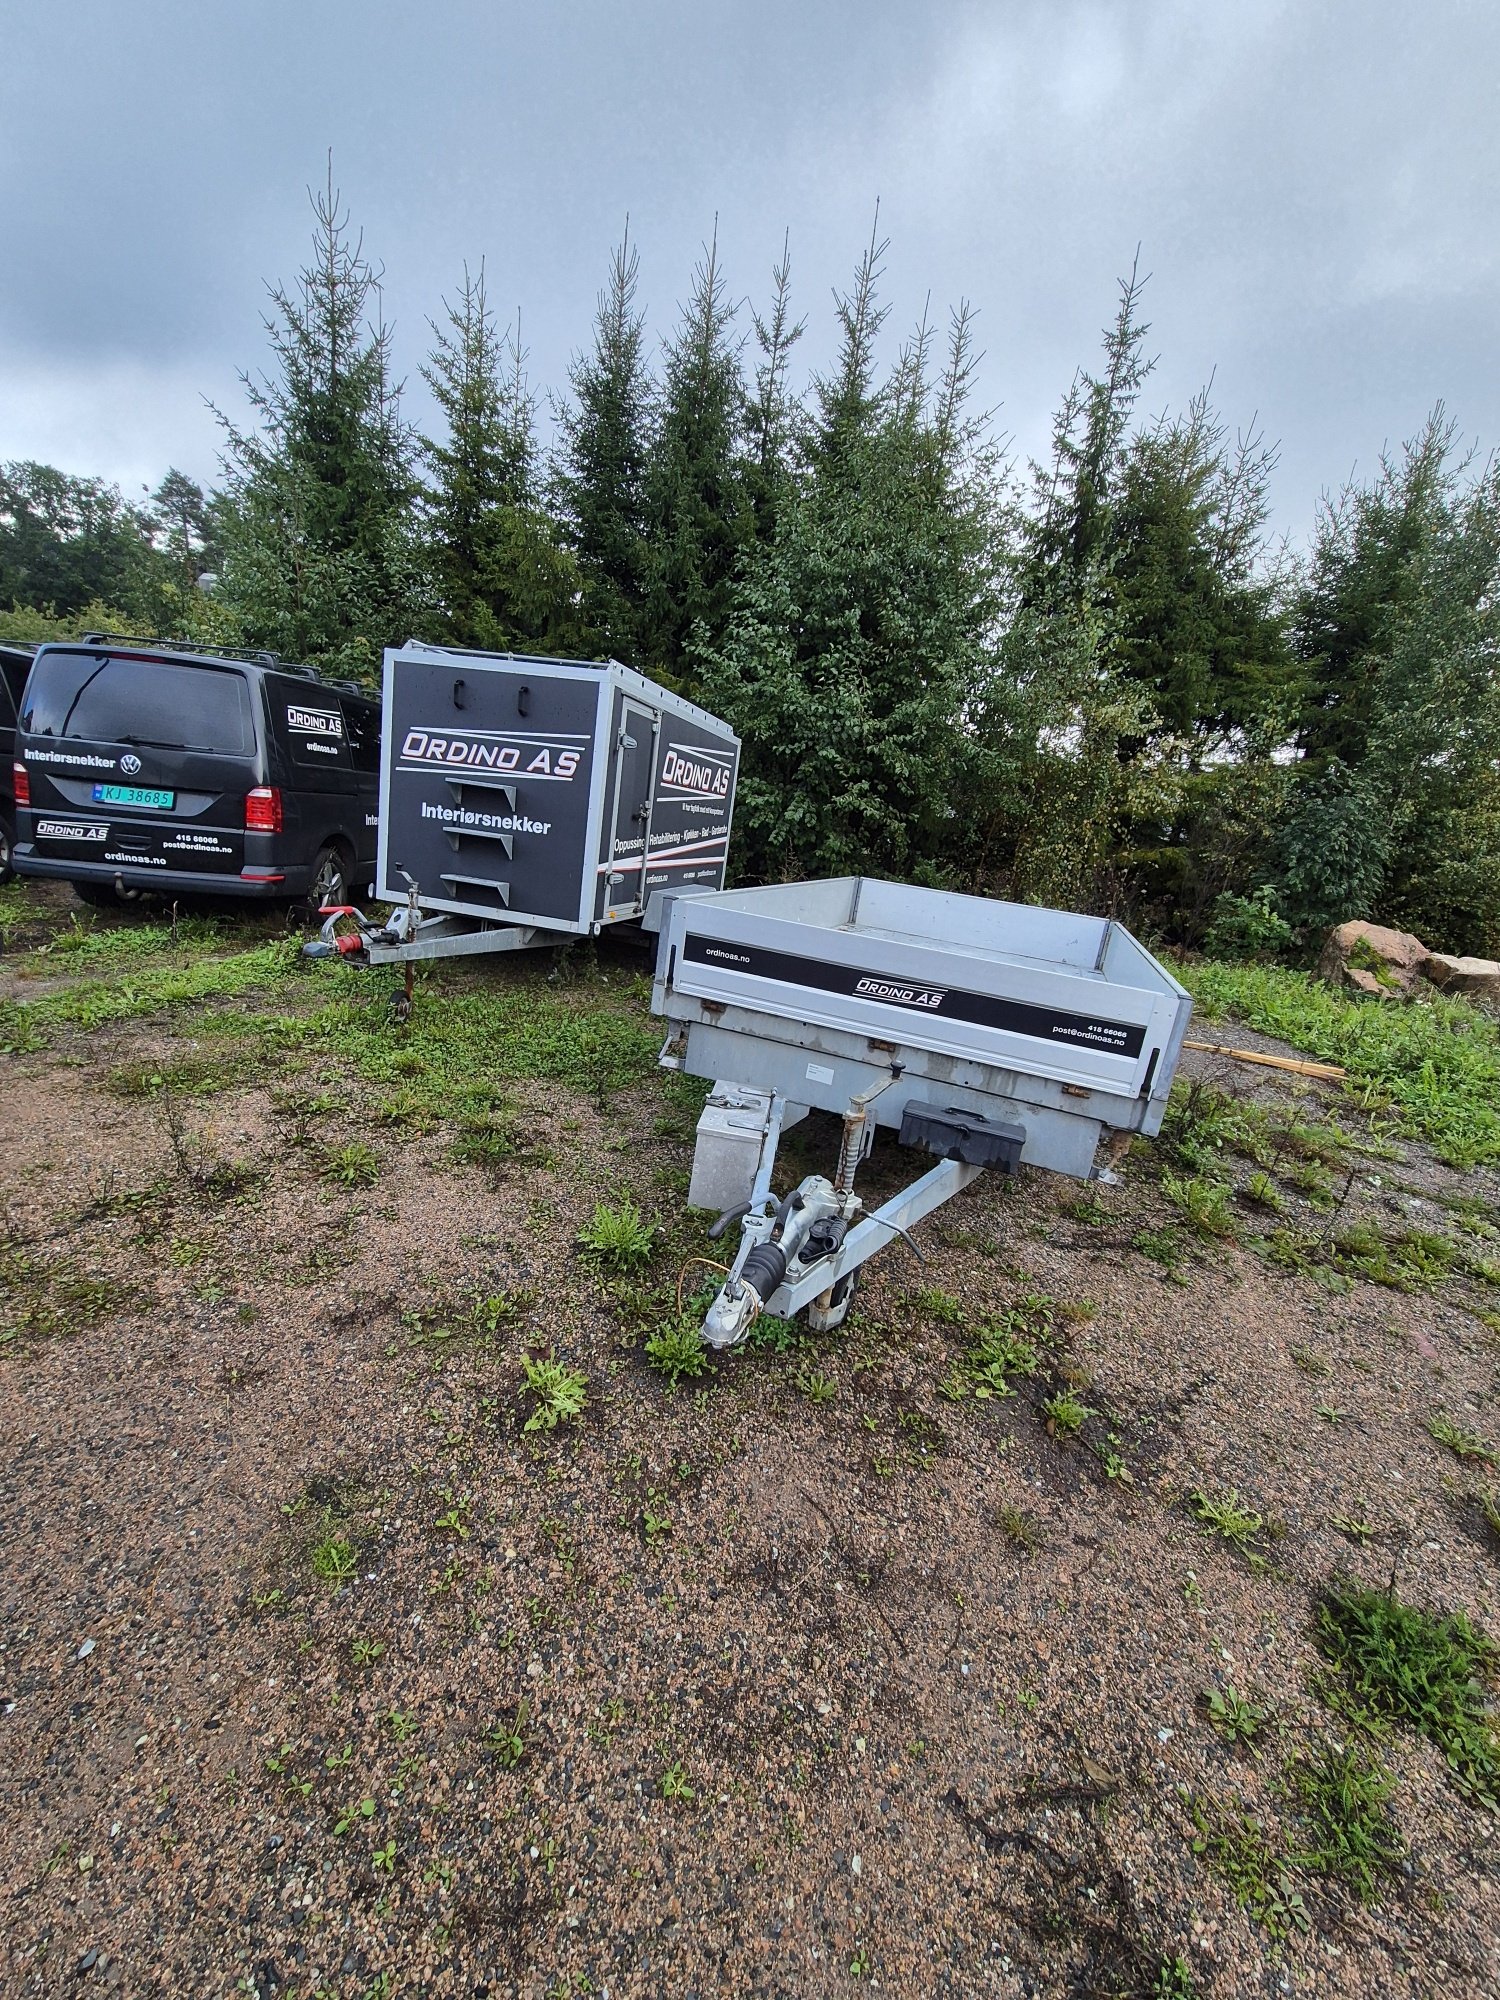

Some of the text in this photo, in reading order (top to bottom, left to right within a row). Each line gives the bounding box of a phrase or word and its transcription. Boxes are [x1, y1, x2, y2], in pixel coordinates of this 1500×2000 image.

[287, 708, 342, 733] ORDINO AS
[24, 748, 116, 769] Interiørsnekker
[402, 732, 581, 777] ORDINO AS
[662, 750, 730, 795] ORDINO AS
[105, 788, 169, 804] KJ 38685
[421, 802, 551, 834] Interiørsnekker
[37, 822, 108, 839] ORDINO AS
[175, 834, 191, 842] 415
[163, 841, 232, 854] post@ordinoas.no
[104, 852, 167, 865] ordinoas.no
[706, 948, 750, 963] ordinoas.no
[857, 979, 942, 1006] ORDINO AS
[1052, 1026, 1125, 1046] post@ordinoas.no
